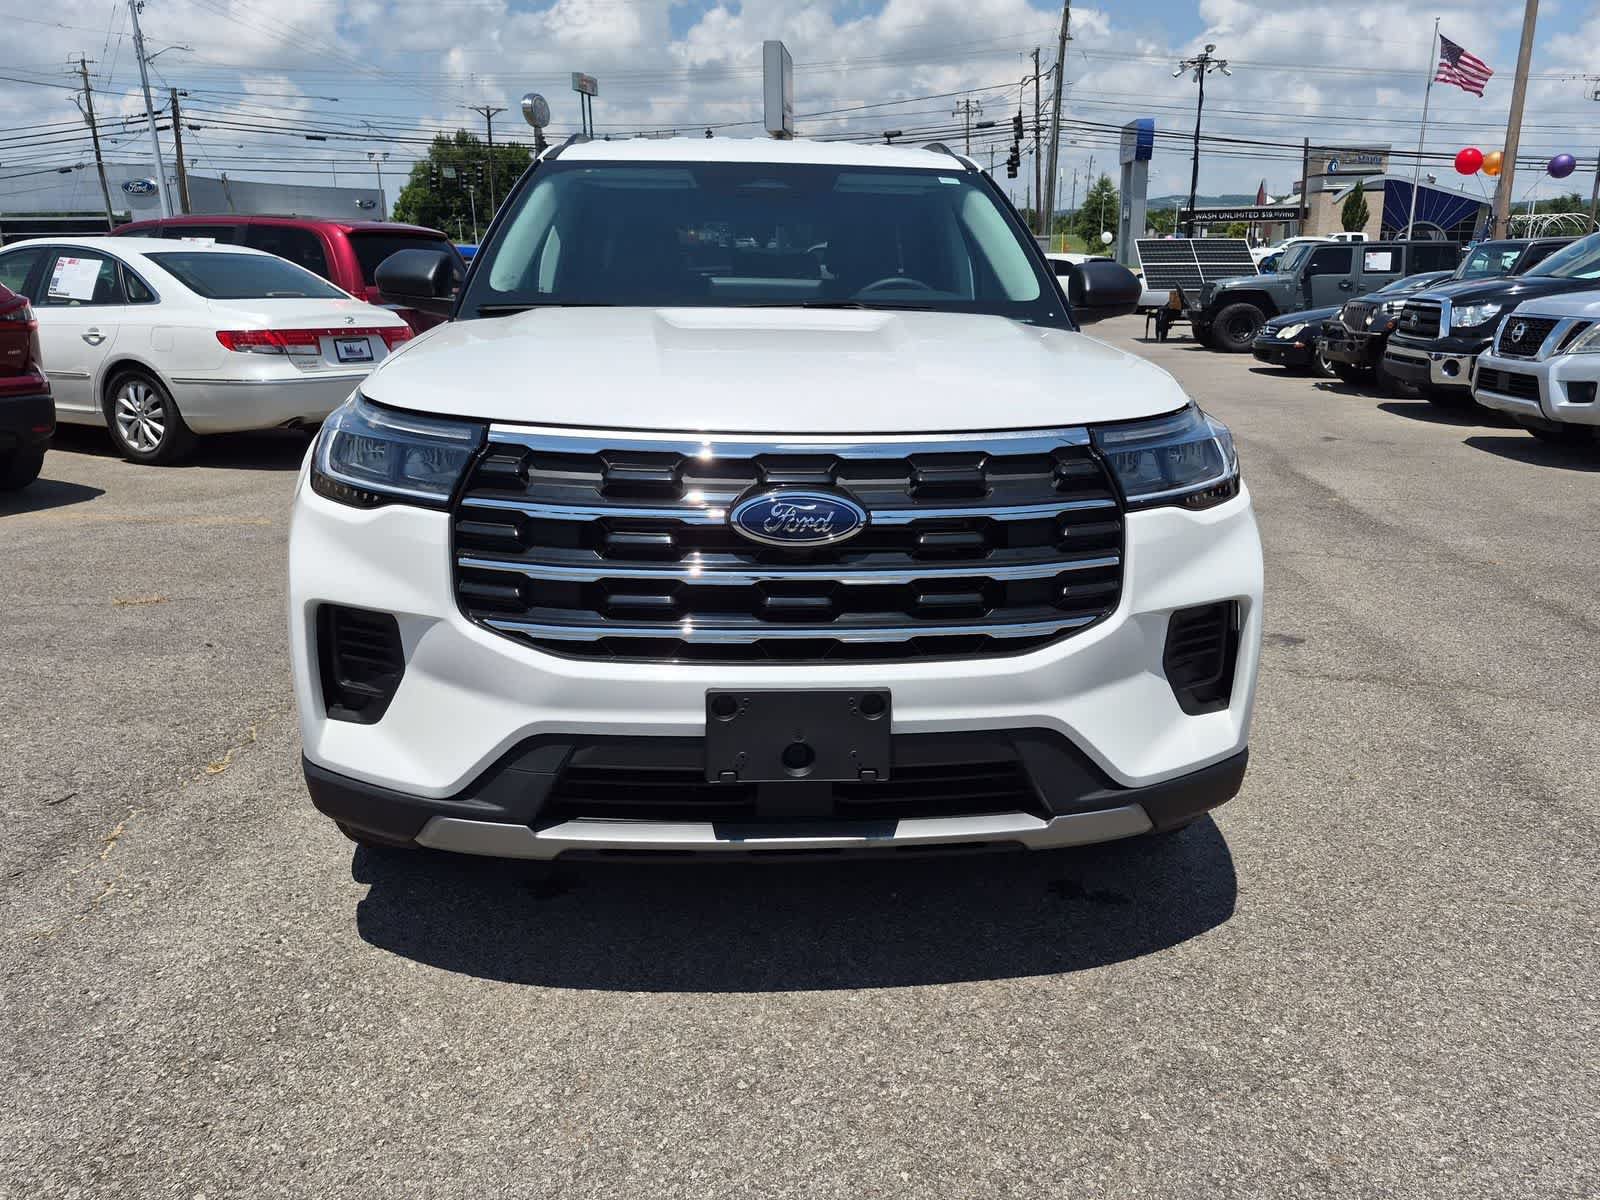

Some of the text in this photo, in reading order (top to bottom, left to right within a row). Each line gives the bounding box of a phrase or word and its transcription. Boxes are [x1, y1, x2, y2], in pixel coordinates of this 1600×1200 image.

[128, 182, 148, 192] Ford
[1195, 212, 1217, 220] WASH
[1218, 211, 1259, 219] UNLIMITED
[763, 502, 834, 533] Ford
